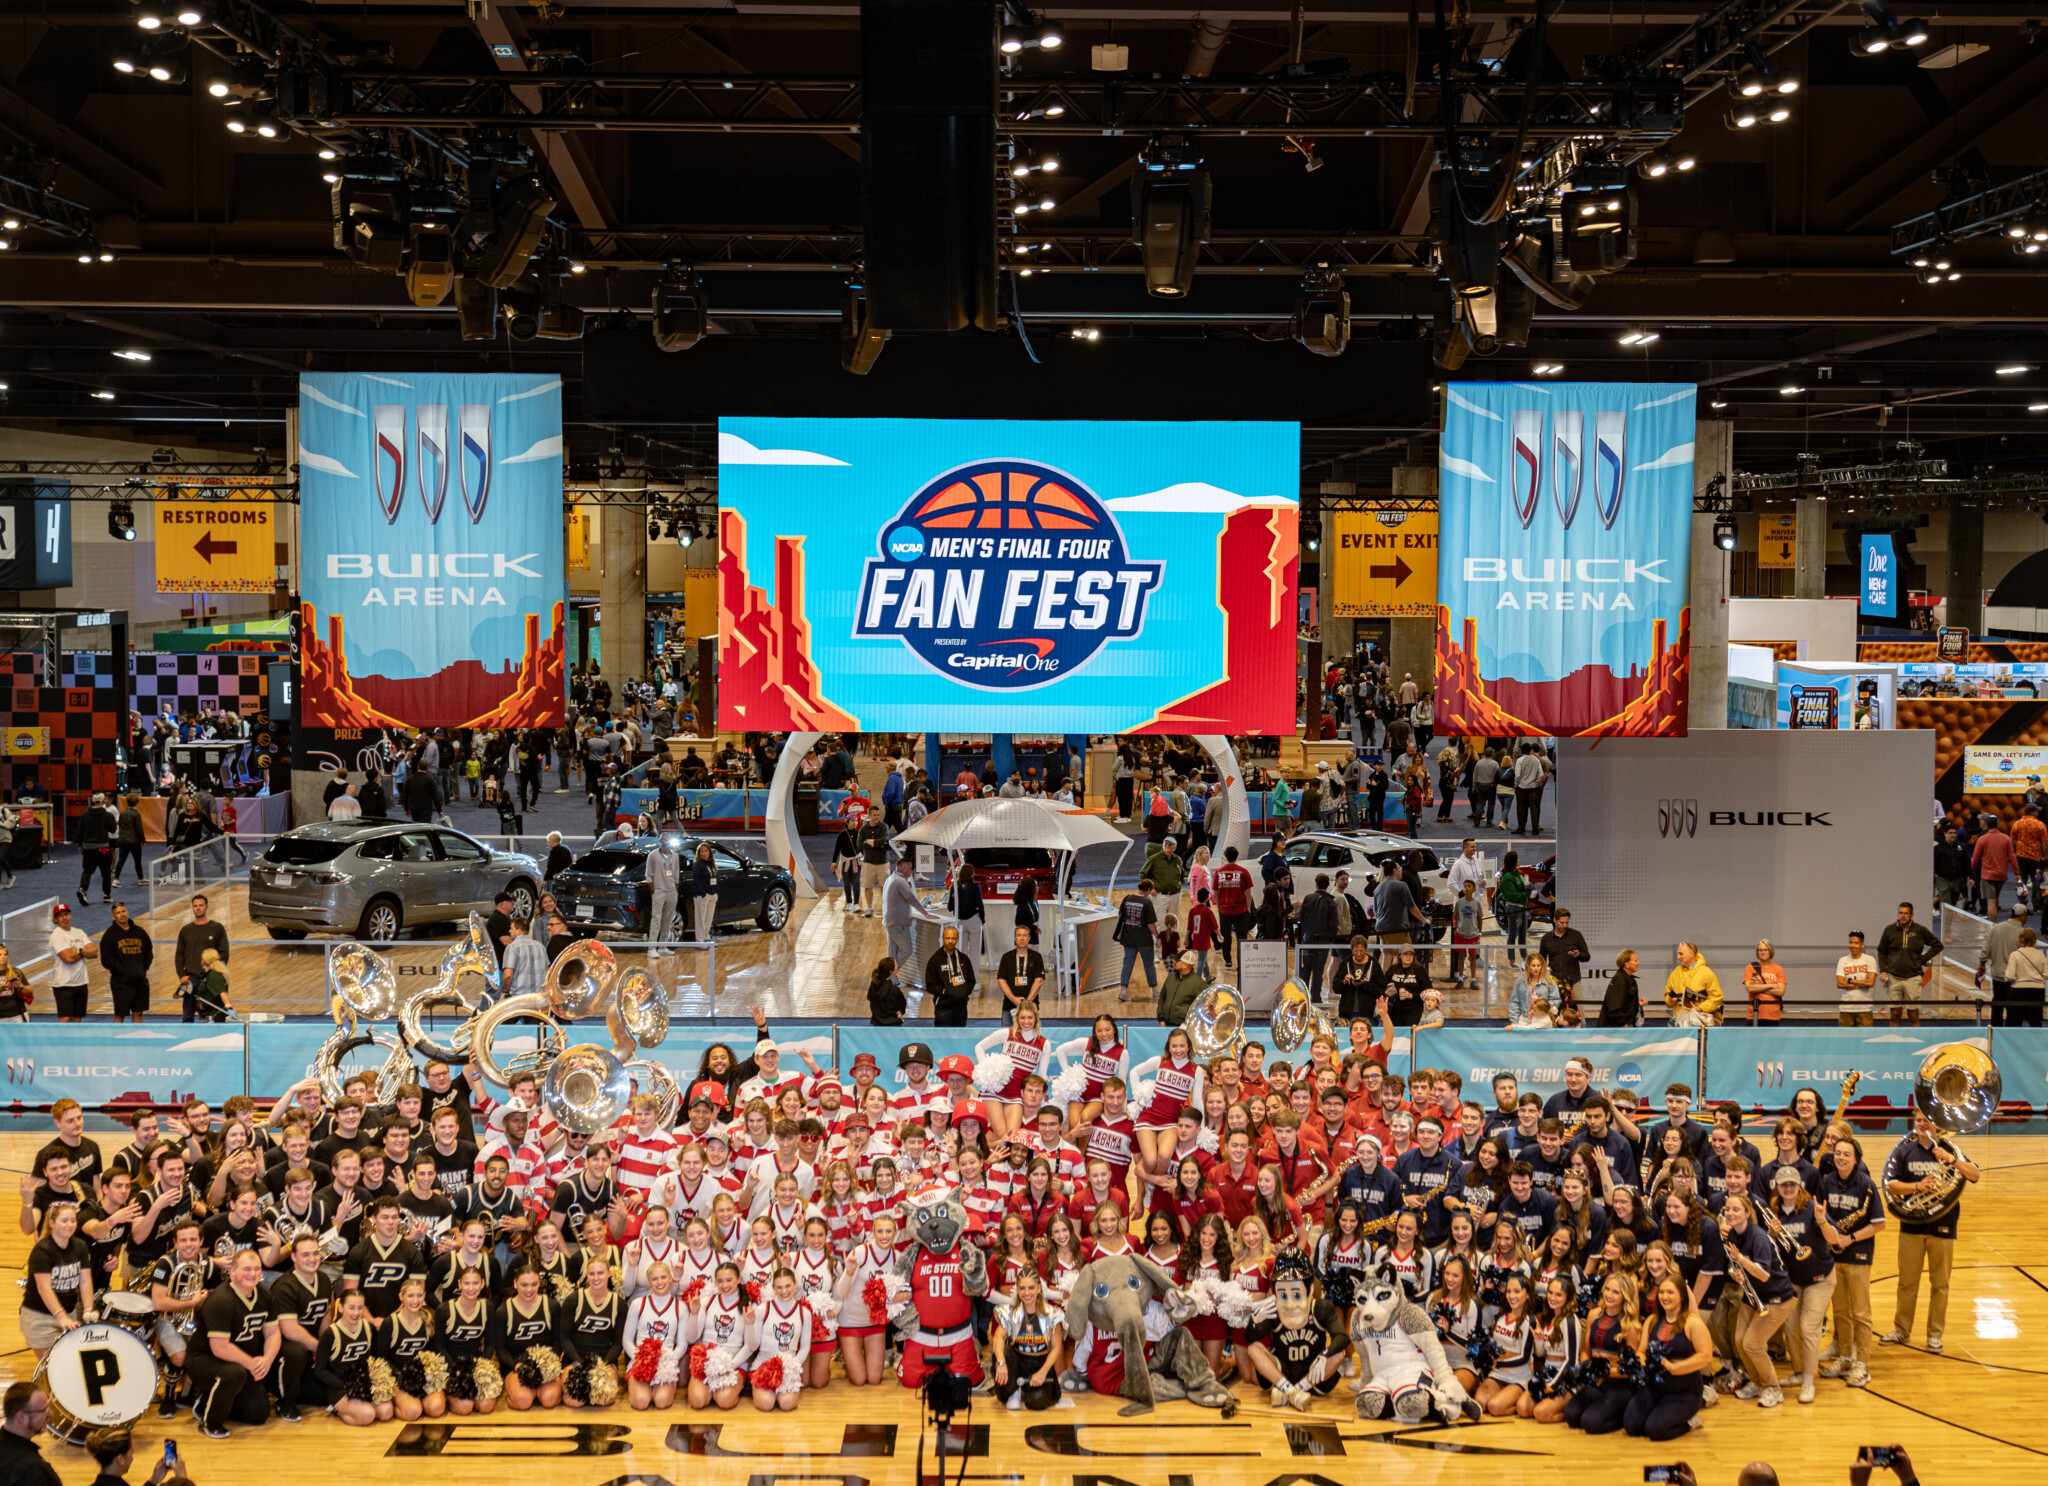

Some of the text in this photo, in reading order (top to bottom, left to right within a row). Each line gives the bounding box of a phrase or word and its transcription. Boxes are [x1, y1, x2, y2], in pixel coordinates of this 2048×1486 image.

[163, 511, 267, 524] RESTROOMS
[1376, 514, 1407, 522] FAN FEST
[892, 543, 924, 554] NCAA
[930, 538, 1110, 560] MEN'S FINAL FOUR
[1342, 534, 1398, 548] EVENT
[326, 554, 544, 578] BUICK
[1464, 558, 1672, 584] BUICK
[1869, 578, 1880, 590] MEN
[362, 587, 506, 606] ARENA
[864, 568, 1153, 630] FAN FEST
[1495, 591, 1636, 610] ARENA
[934, 638, 967, 646] PRESENTED BY
[1943, 634, 1962, 642] FINAL
[1796, 698, 1829, 710] FINAL
[1796, 710, 1828, 722] FOUR
[334, 728, 362, 740] PRIZE
[1710, 812, 1833, 826] BUICK
[1006, 1042, 1040, 1062] ALABAMA
[43, 1066, 192, 1077] BUICK ARENA
[1159, 1070, 1192, 1090] ALABAMA
[1533, 1068, 1561, 1082] SUV
[1618, 1074, 1642, 1082] NCAA
[364, 1262, 407, 1288] P
[920, 1263, 960, 1276] NC STATE
[928, 1275, 952, 1297] 00
[300, 1298, 330, 1325] P
[236, 1312, 268, 1342] P
[514, 1321, 546, 1340] P
[578, 1315, 612, 1333] P
[81, 1329, 110, 1343] Pearl
[450, 1326, 484, 1341] P
[1281, 1328, 1319, 1346] PURDUE
[341, 1342, 370, 1362] P
[396, 1338, 427, 1356] P
[1288, 1345, 1309, 1362] 00
[78, 1346, 123, 1408] P
[383, 1421, 1555, 1458] BUICK
